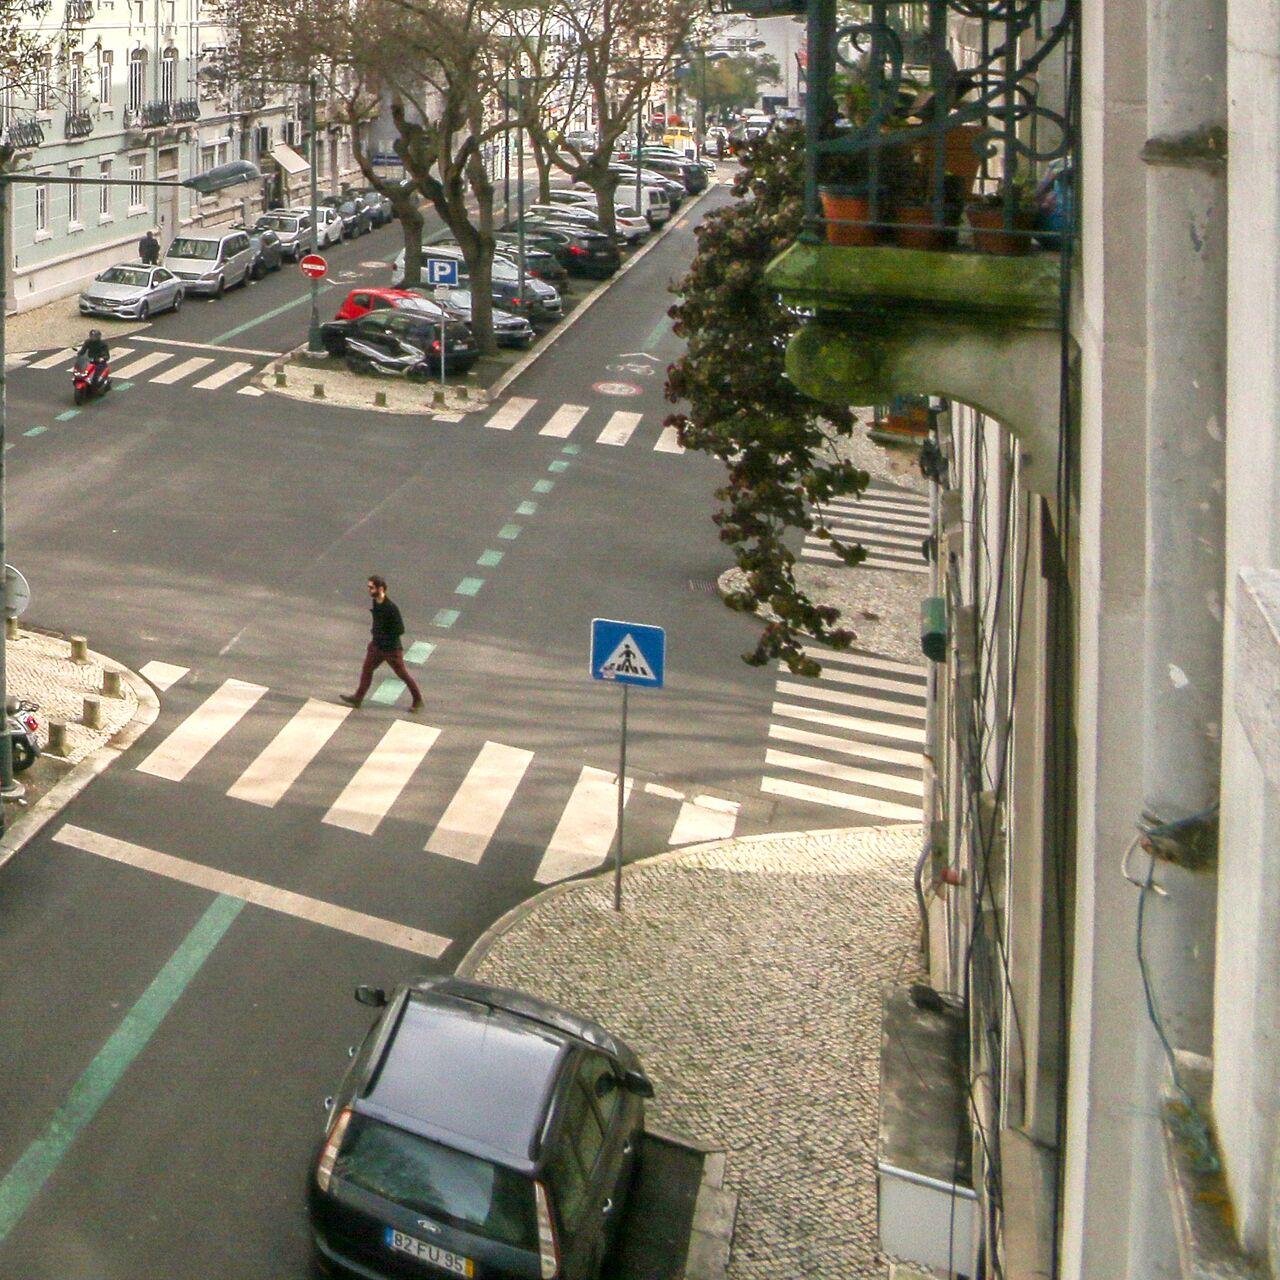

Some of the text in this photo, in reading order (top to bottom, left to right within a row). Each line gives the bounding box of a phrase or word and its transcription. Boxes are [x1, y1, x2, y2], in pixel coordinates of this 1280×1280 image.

[433, 262, 451, 282] P
[394, 1233, 463, 1272] 82 FU 95
